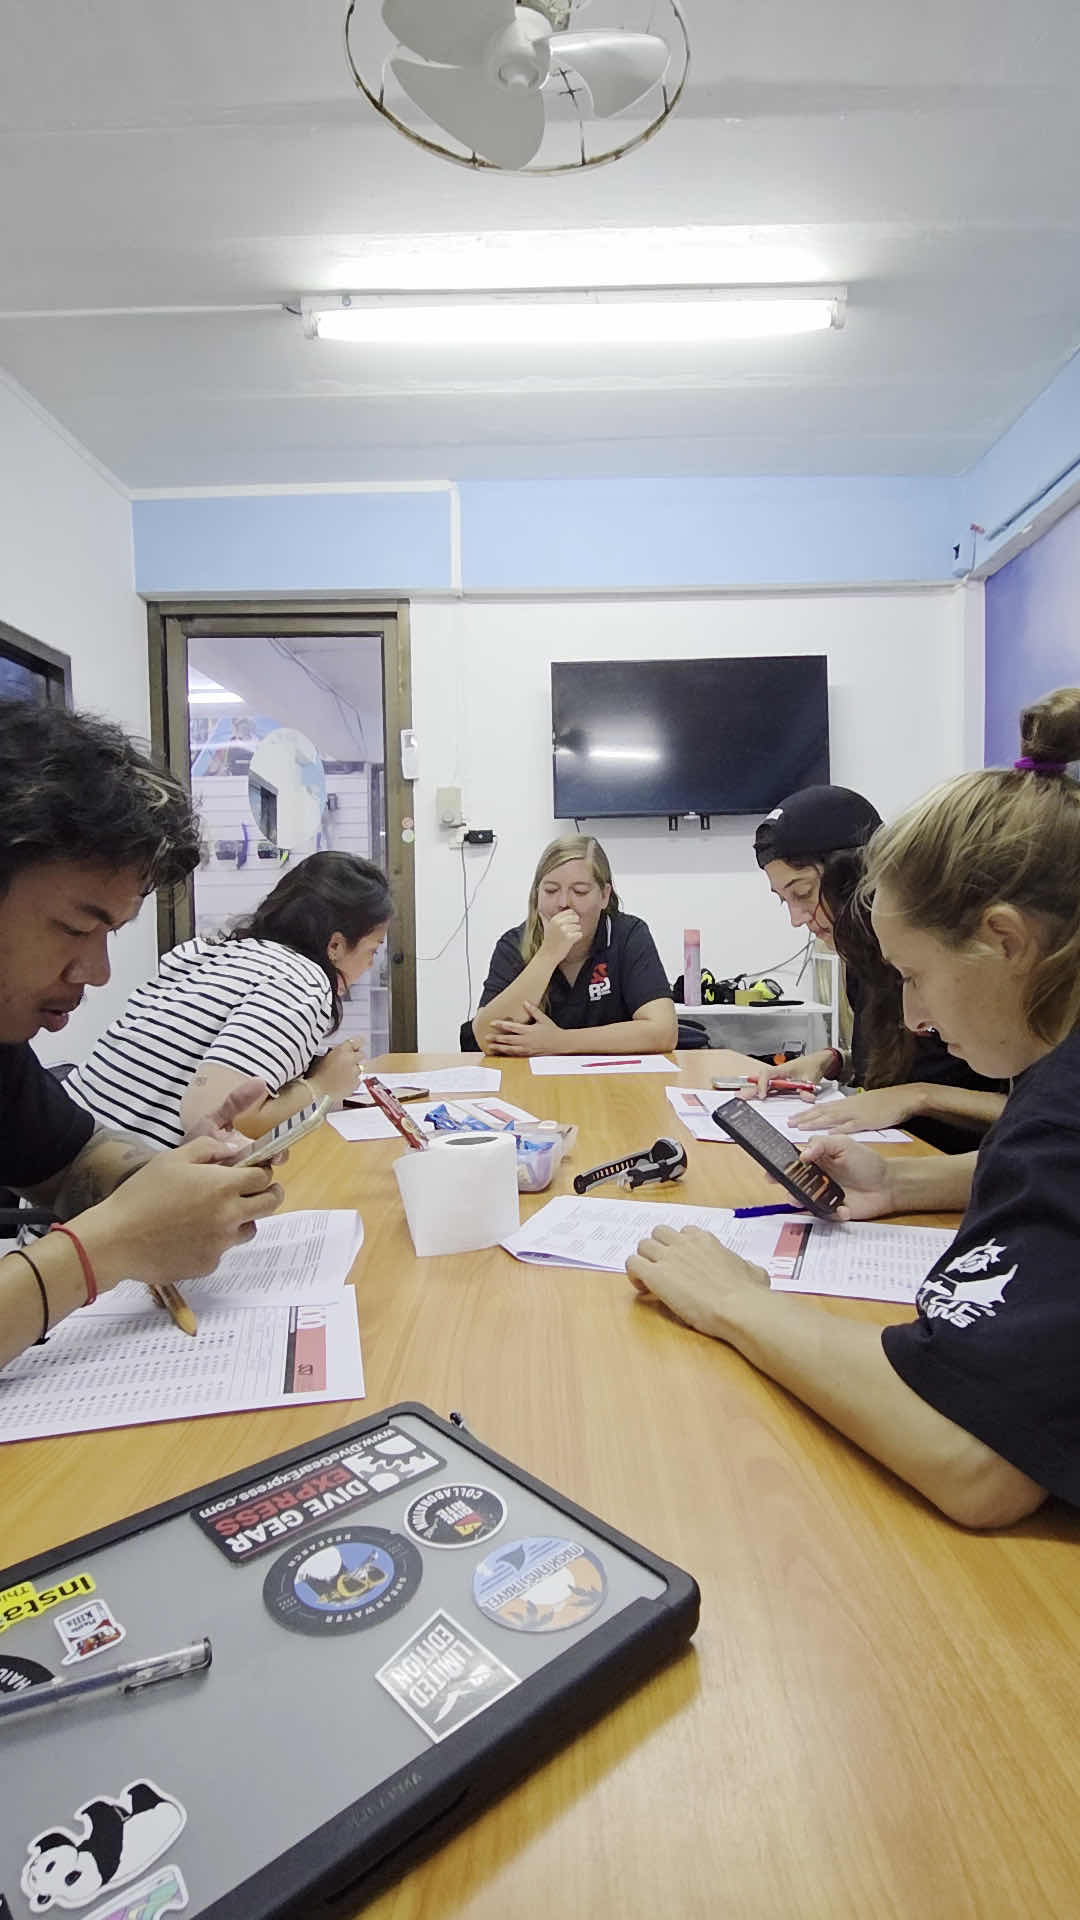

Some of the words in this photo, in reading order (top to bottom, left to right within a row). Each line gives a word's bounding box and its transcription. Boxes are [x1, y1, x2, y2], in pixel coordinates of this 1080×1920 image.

[199, 1428, 397, 1519] www.DiveGearExpress.com
[215, 1465, 352, 1536] EXPRESS
[302, 1479, 369, 1517] DIVE
[224, 1509, 304, 1553] GEAR
[391, 1623, 455, 1690] EDITION
[408, 1640, 473, 1708] LIMITED
